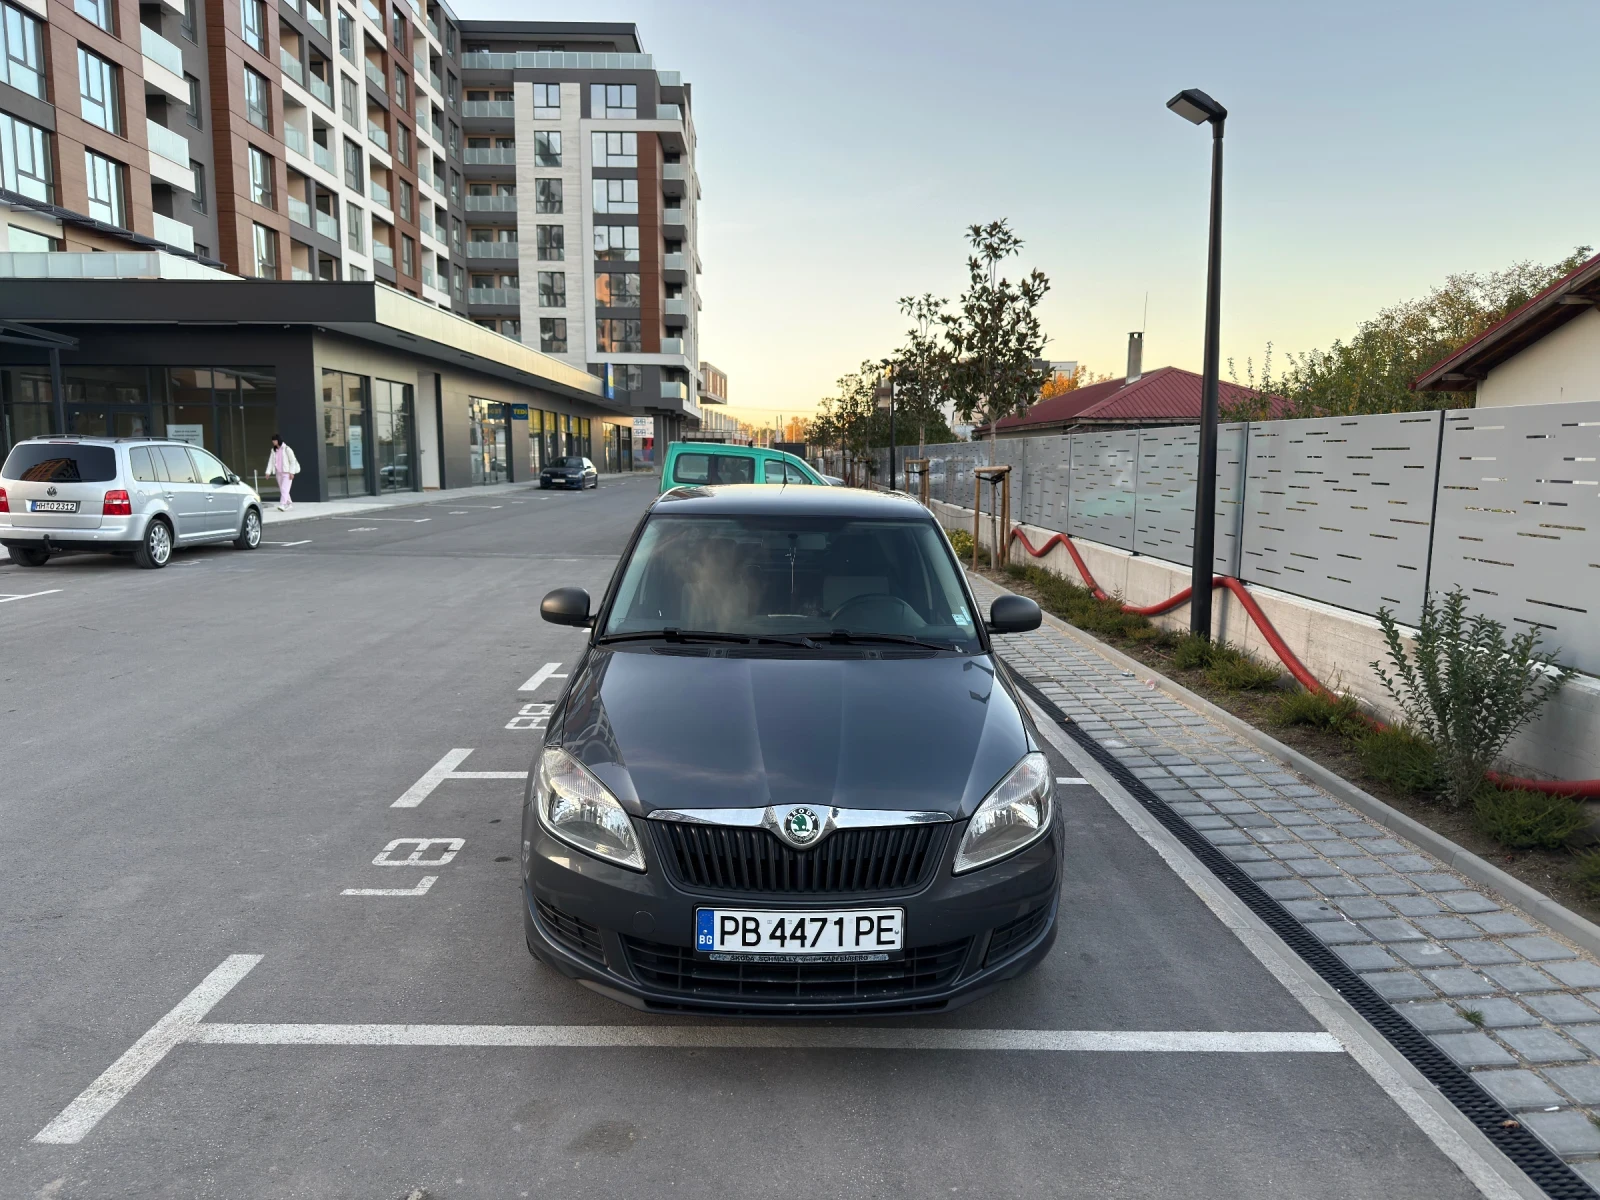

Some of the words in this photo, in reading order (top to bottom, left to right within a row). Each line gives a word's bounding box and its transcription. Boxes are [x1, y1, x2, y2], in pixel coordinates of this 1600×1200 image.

[56, 502, 74, 510] 2312
[719, 915, 761, 947] PB
[769, 917, 844, 948] 4471
[854, 915, 895, 947] PE
[699, 935, 713, 945] BG
